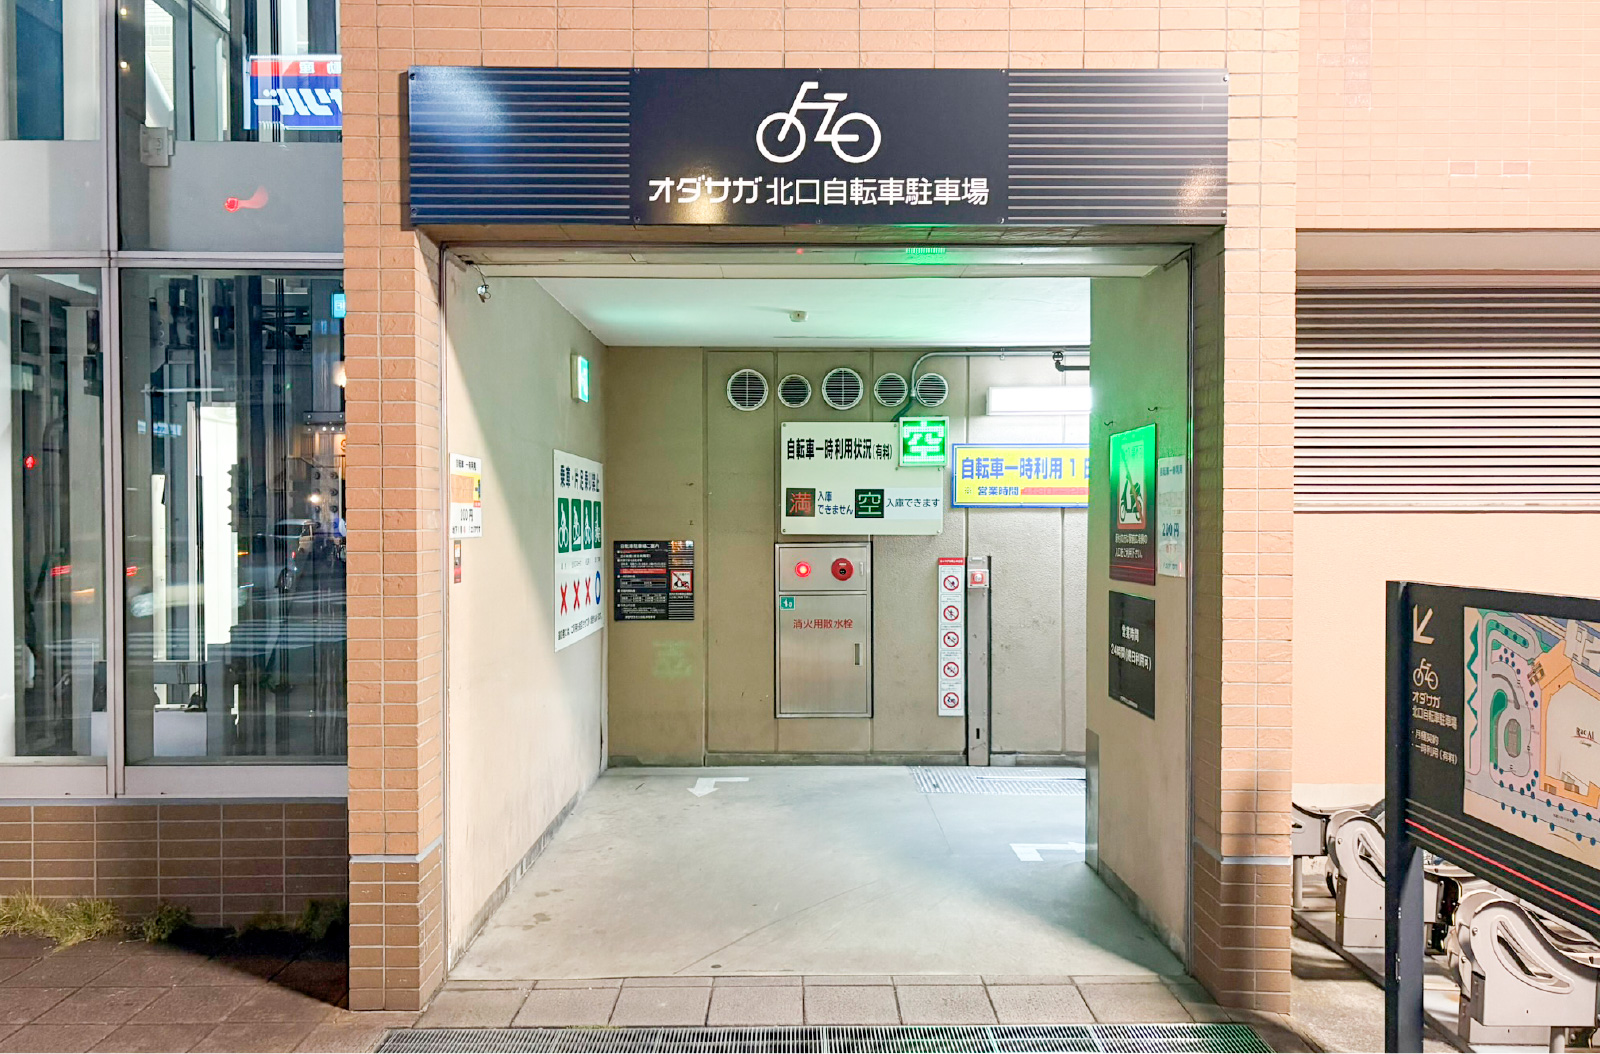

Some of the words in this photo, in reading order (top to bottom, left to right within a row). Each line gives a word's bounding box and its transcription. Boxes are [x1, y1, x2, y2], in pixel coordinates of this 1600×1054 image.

[786, 437, 893, 461] 自転車一時利用状況(有料)
[901, 419, 946, 464] 空
[817, 490, 833, 502] 入庫
[977, 486, 1019, 496] 営業時間
[789, 490, 812, 515] 満
[817, 503, 854, 516] できません
[857, 490, 883, 516] 空
[885, 497, 940, 509] 入庫できます
[792, 618, 853, 630] 消火用散水栓
[1411, 690, 1441, 709] オダサガ
